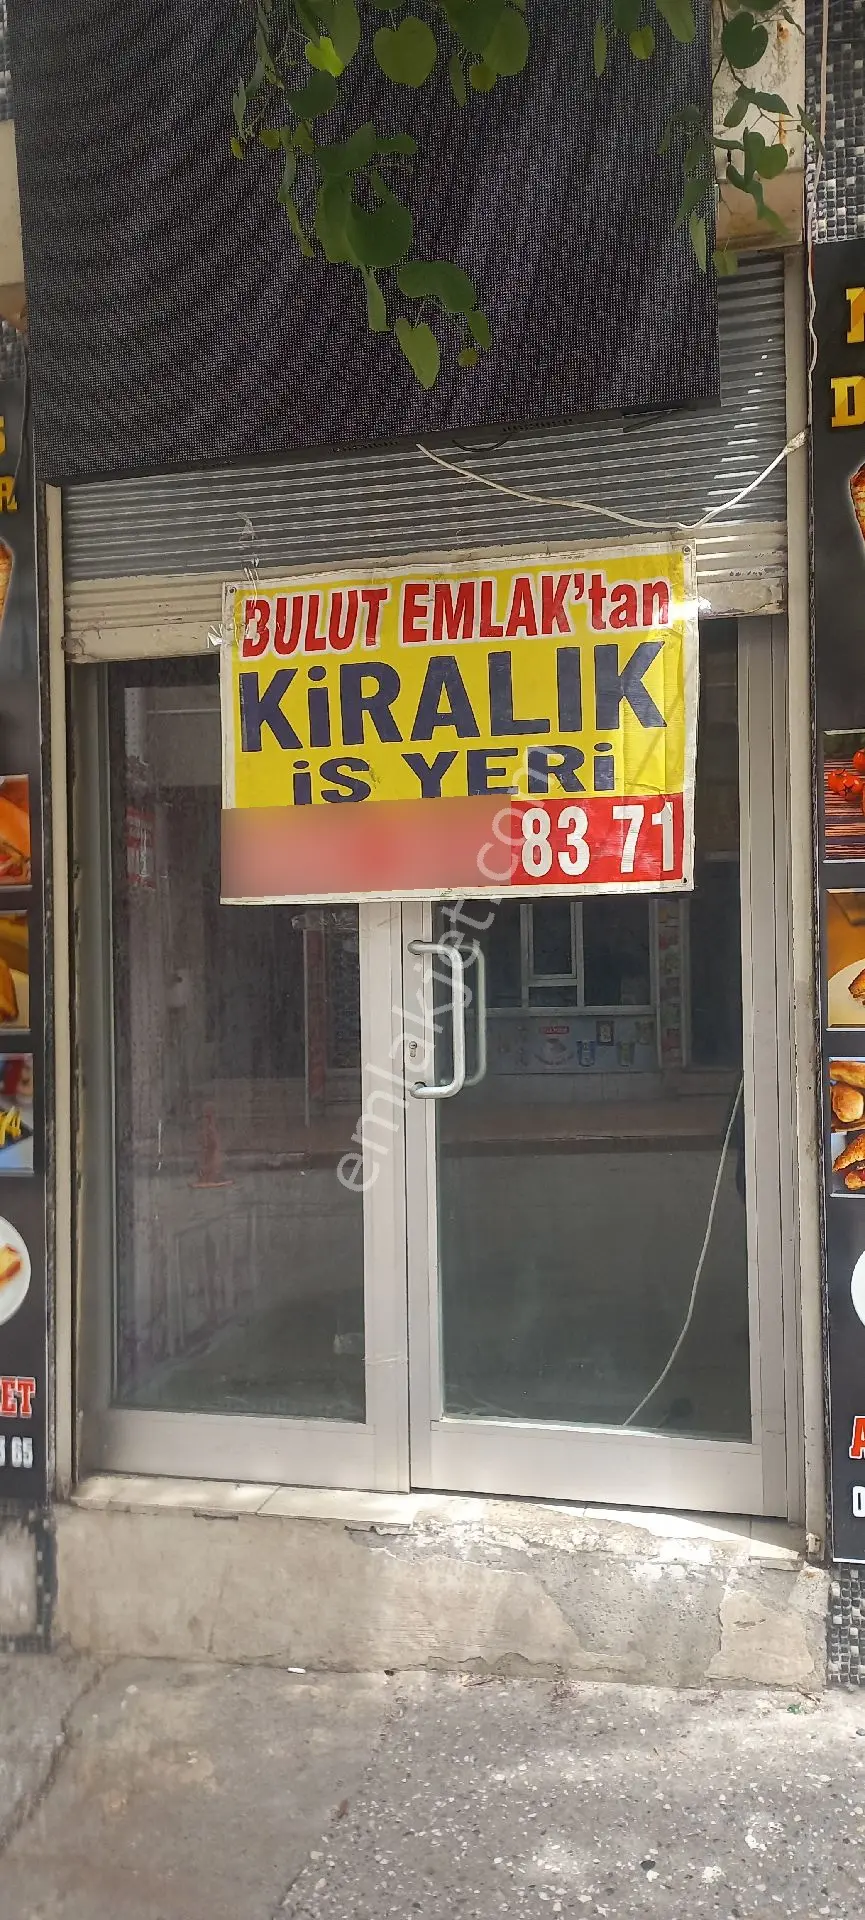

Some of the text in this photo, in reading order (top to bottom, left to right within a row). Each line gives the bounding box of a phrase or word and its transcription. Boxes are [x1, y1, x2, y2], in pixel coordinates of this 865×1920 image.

[241, 588, 388, 658] BULUT
[521, 805, 590, 877] 83
[611, 801, 675, 874] 71
